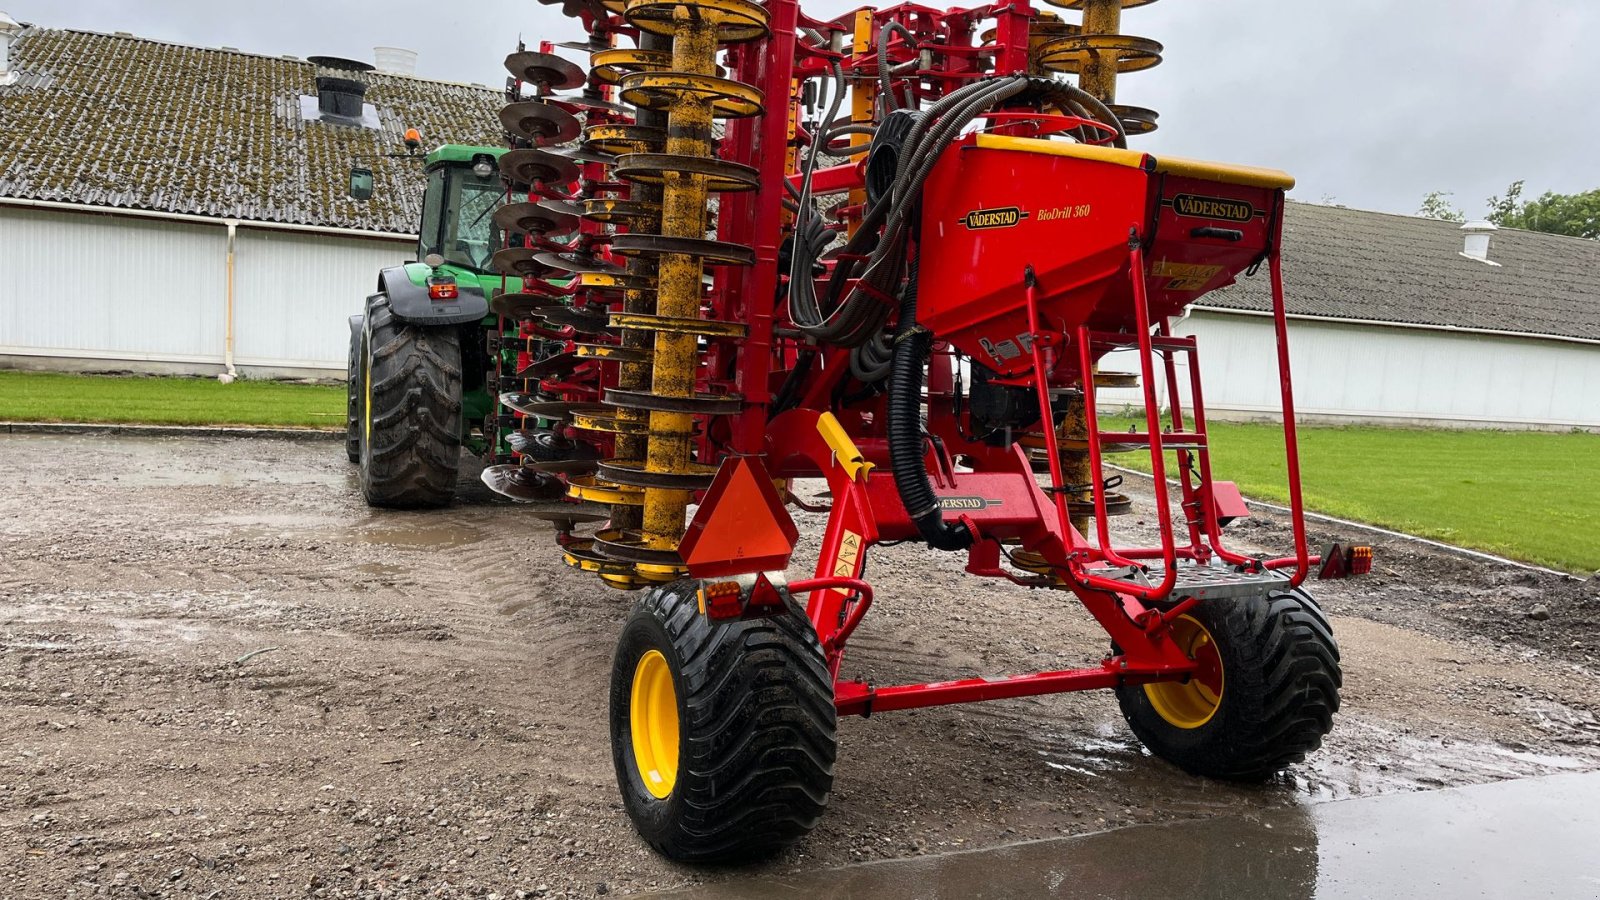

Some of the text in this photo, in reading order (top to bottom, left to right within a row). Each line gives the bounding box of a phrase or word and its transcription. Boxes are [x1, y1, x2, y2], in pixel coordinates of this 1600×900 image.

[1037, 204, 1091, 221] BioDrill 360
[1179, 196, 1249, 219] VÄDERSTAD
[969, 210, 1016, 227] VÄDERSTAD
